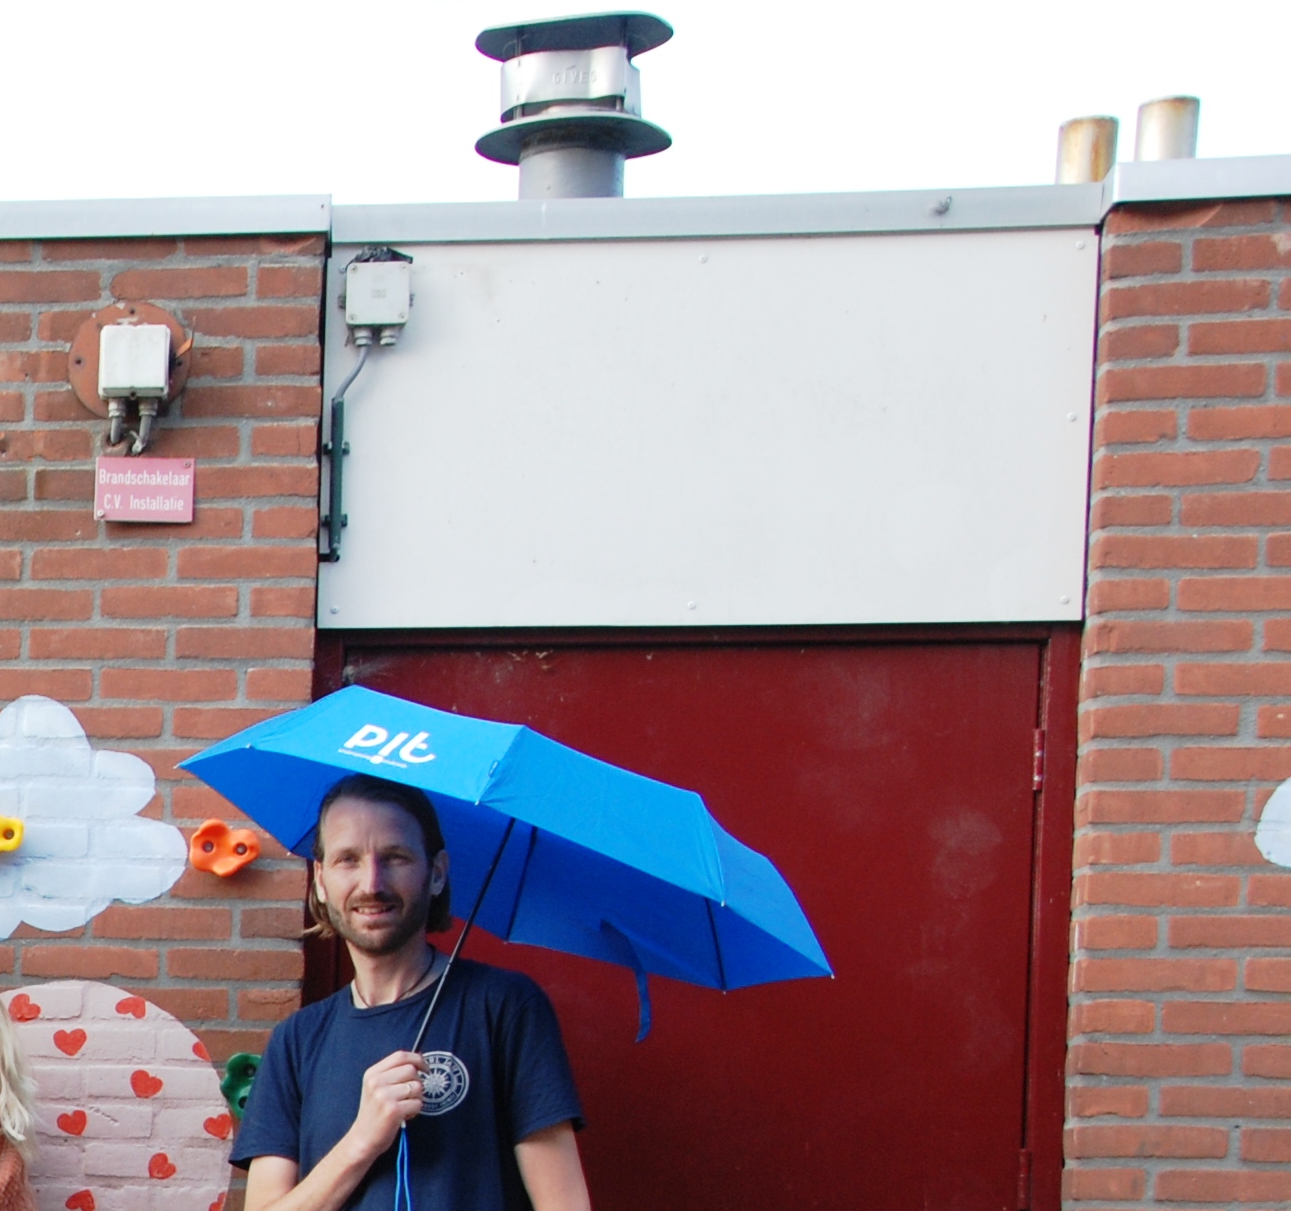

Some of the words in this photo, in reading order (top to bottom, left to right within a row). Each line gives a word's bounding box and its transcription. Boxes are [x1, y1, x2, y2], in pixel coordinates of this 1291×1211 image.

[99, 468, 190, 486] Brandschakelaar
[103, 493, 123, 510] C.V.
[129, 494, 184, 512] Installatie
